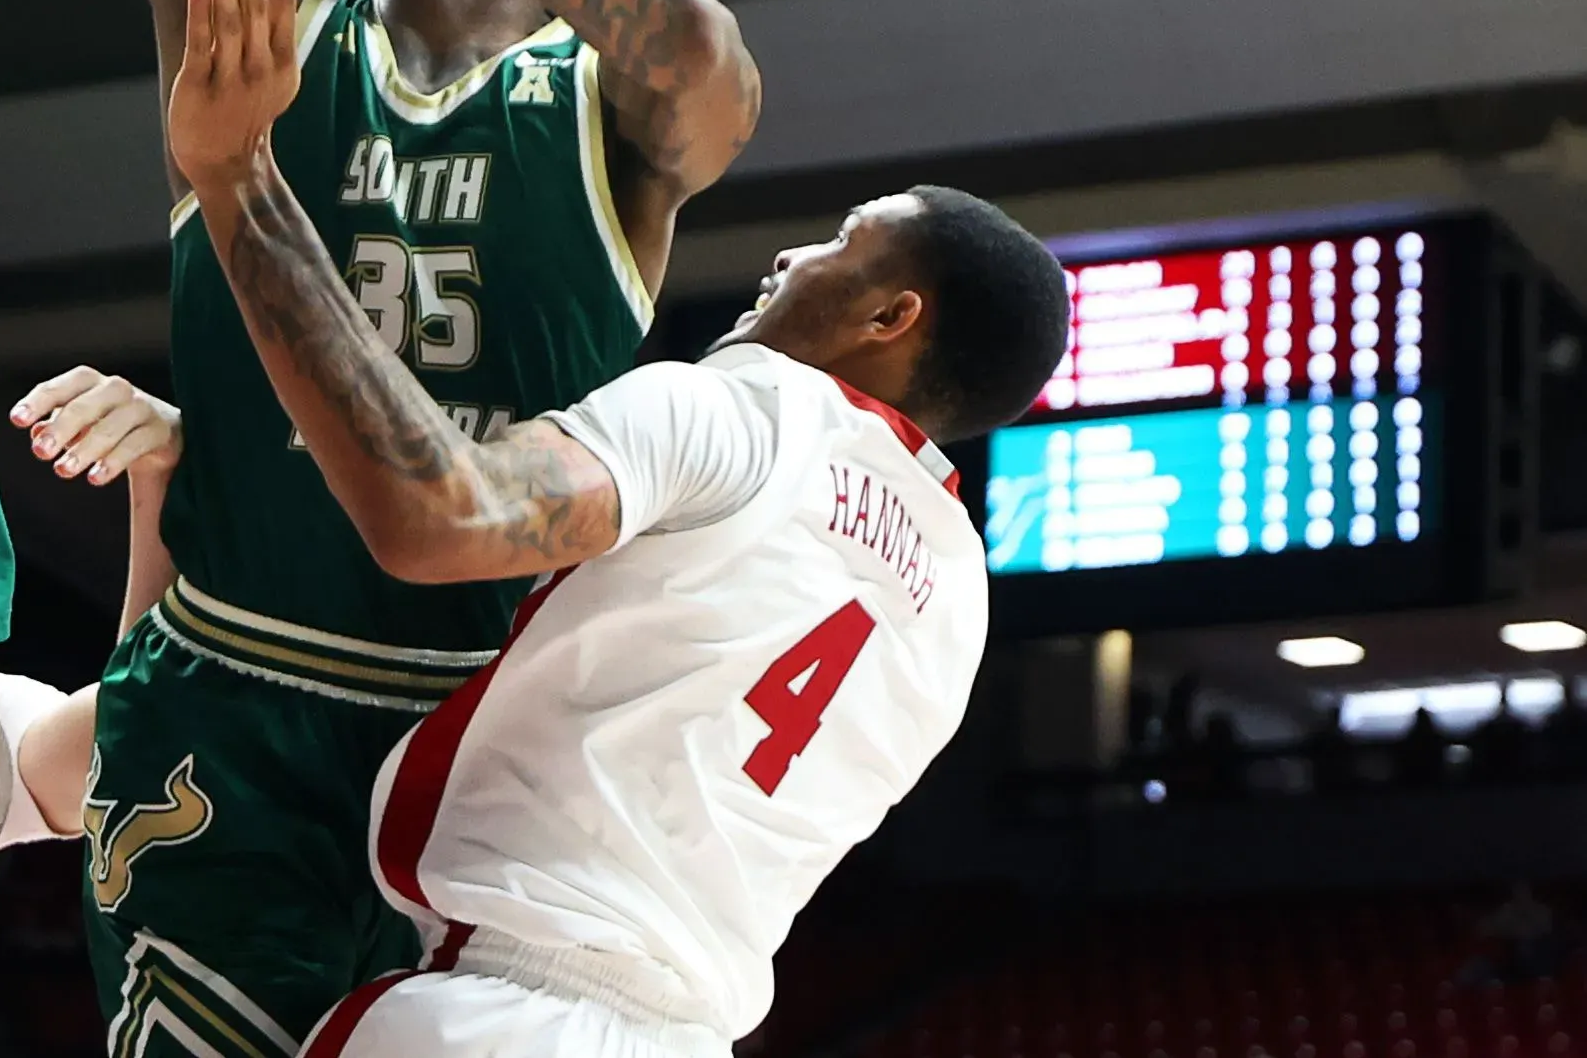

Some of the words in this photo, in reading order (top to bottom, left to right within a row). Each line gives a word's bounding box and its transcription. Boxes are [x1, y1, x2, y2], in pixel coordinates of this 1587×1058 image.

[345, 234, 482, 372] 35
[829, 463, 938, 615] HANNAH
[741, 596, 877, 798] 4
